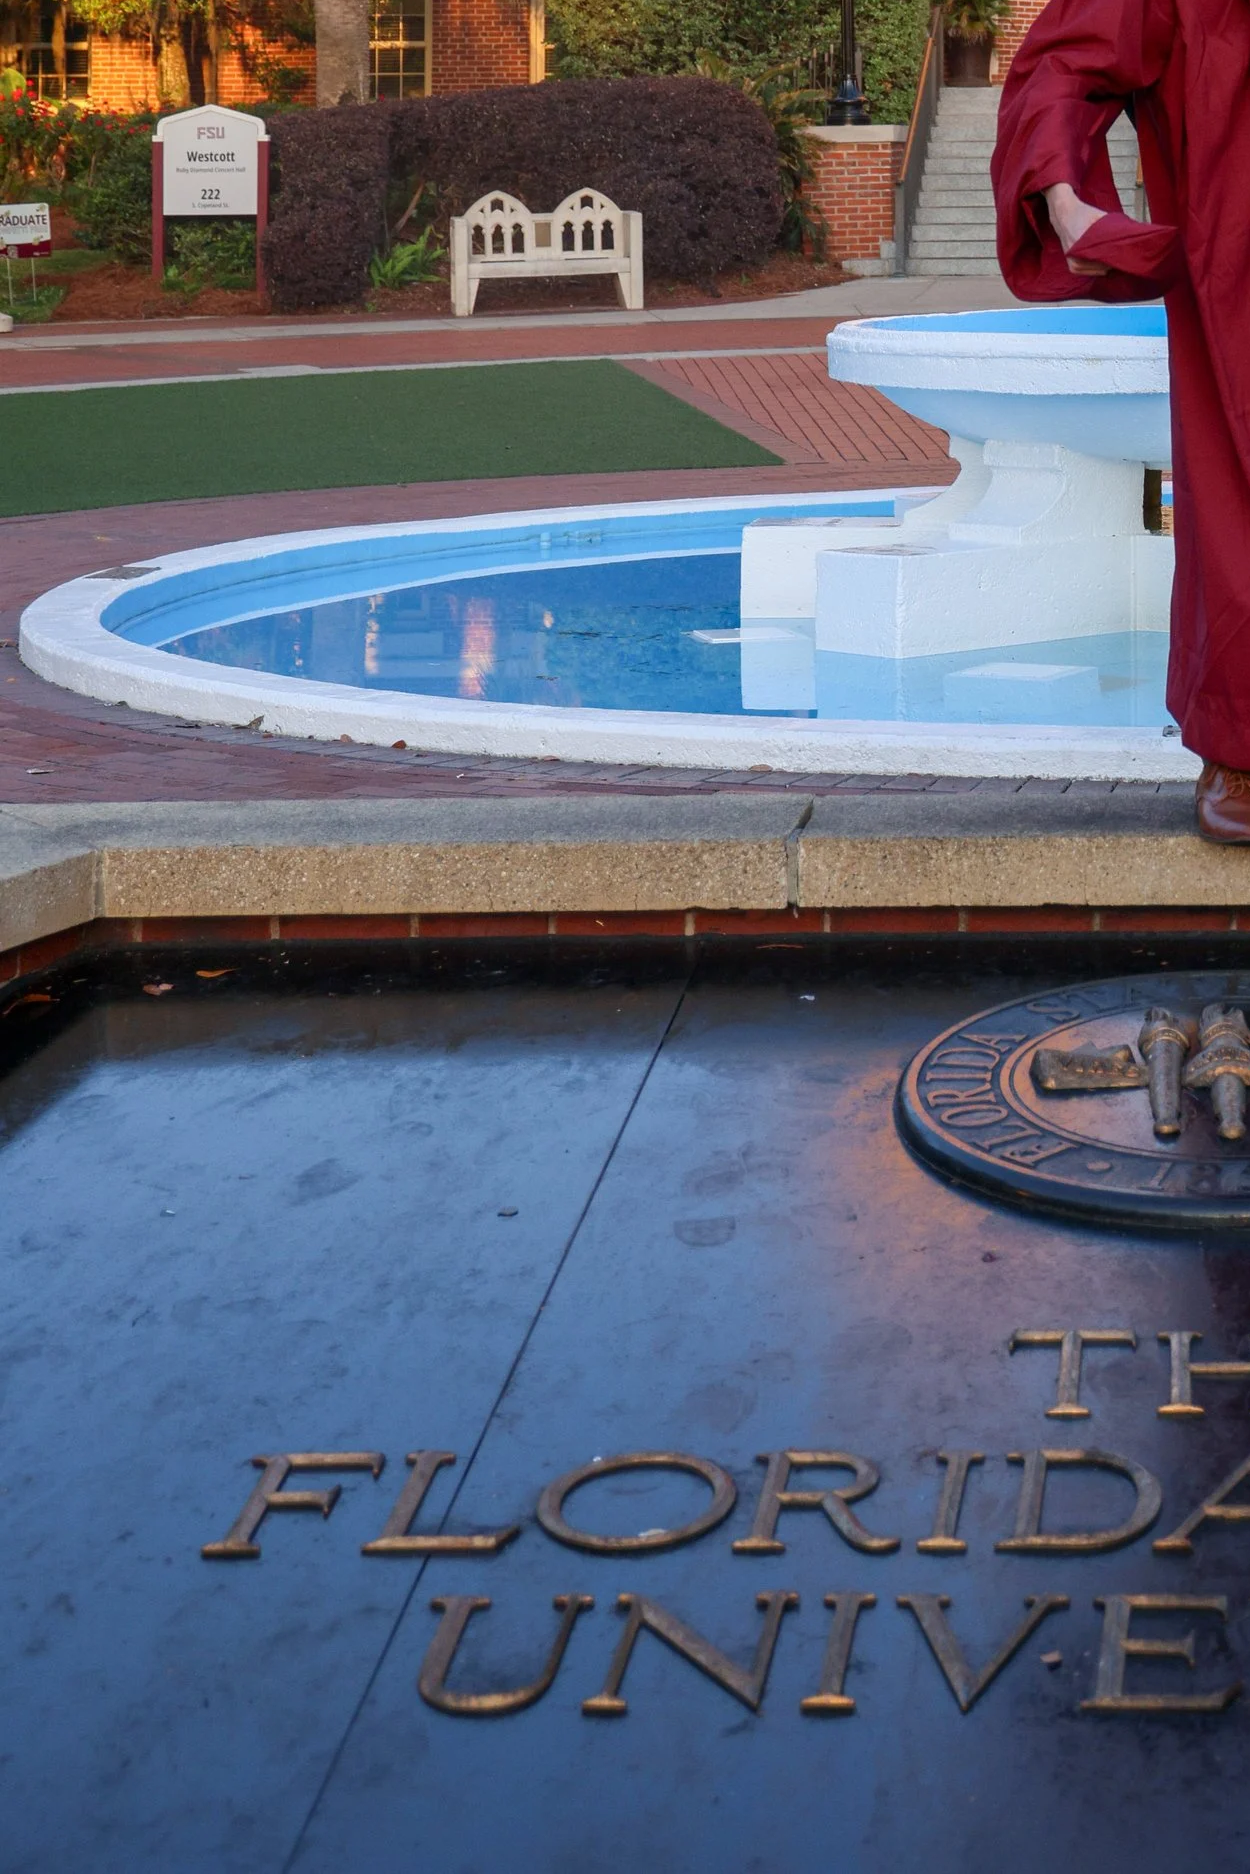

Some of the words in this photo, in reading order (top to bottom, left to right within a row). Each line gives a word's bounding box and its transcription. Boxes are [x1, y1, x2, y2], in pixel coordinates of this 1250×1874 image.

[197, 127, 225, 139] FSU
[187, 151, 236, 163] Westcott
[201, 189, 221, 200] 222
[926, 1033, 1079, 1168] FLORIDA
